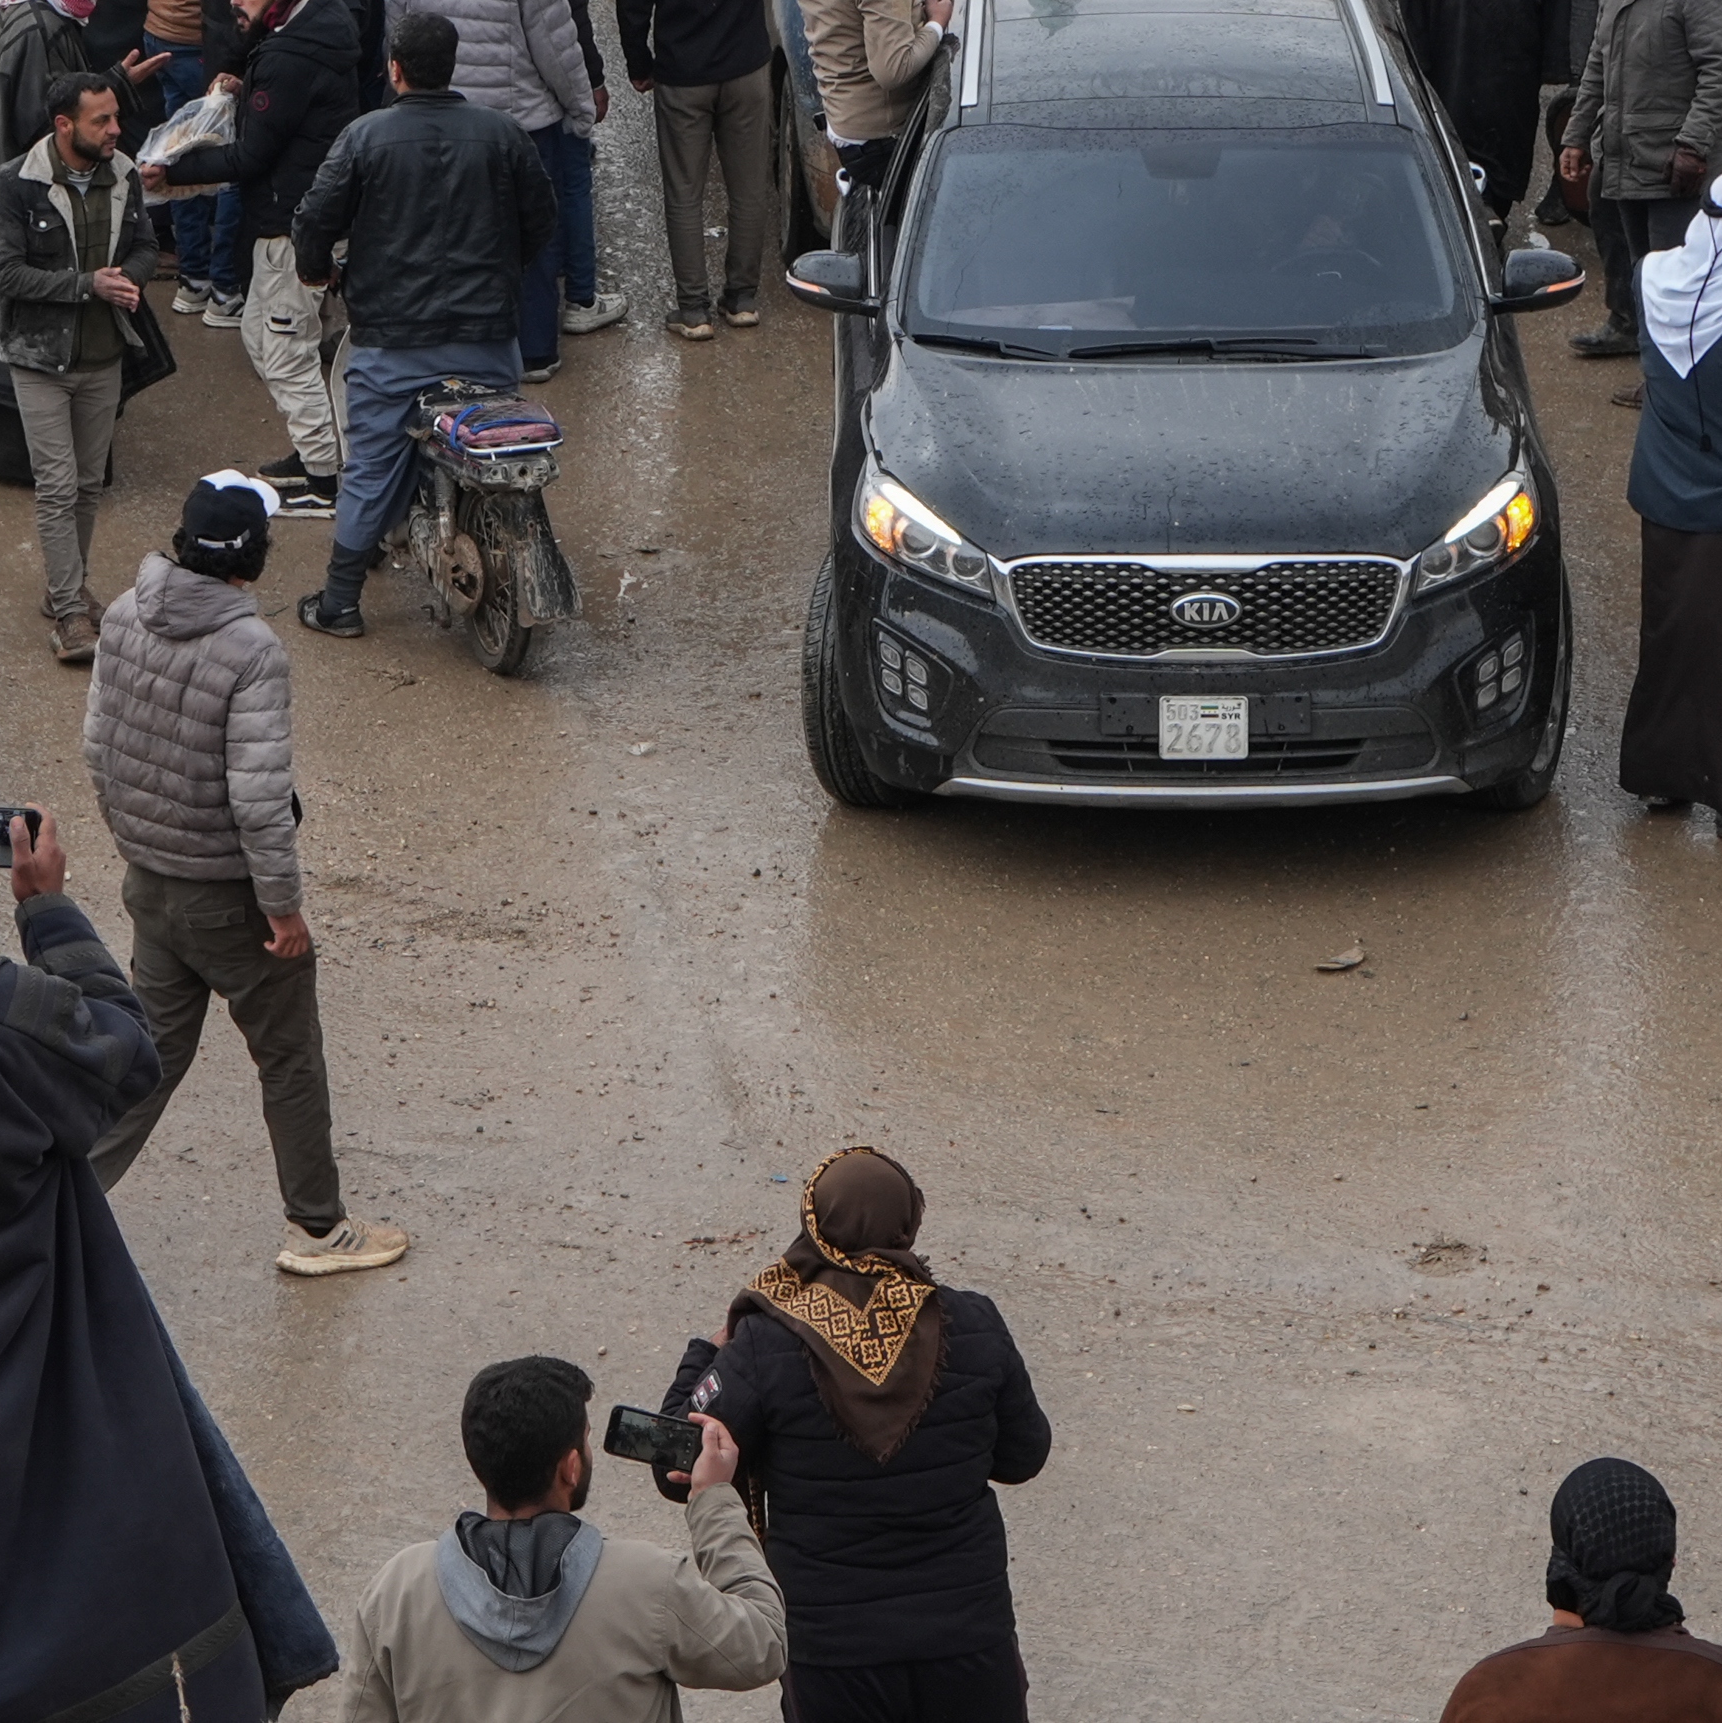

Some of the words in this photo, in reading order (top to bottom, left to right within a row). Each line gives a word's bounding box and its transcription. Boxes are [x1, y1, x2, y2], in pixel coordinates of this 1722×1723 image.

[1182, 602, 1230, 622] KIA
[1165, 703, 1200, 721] 503
[1220, 712, 1241, 720] SYR
[1165, 722, 1243, 754] 2678
